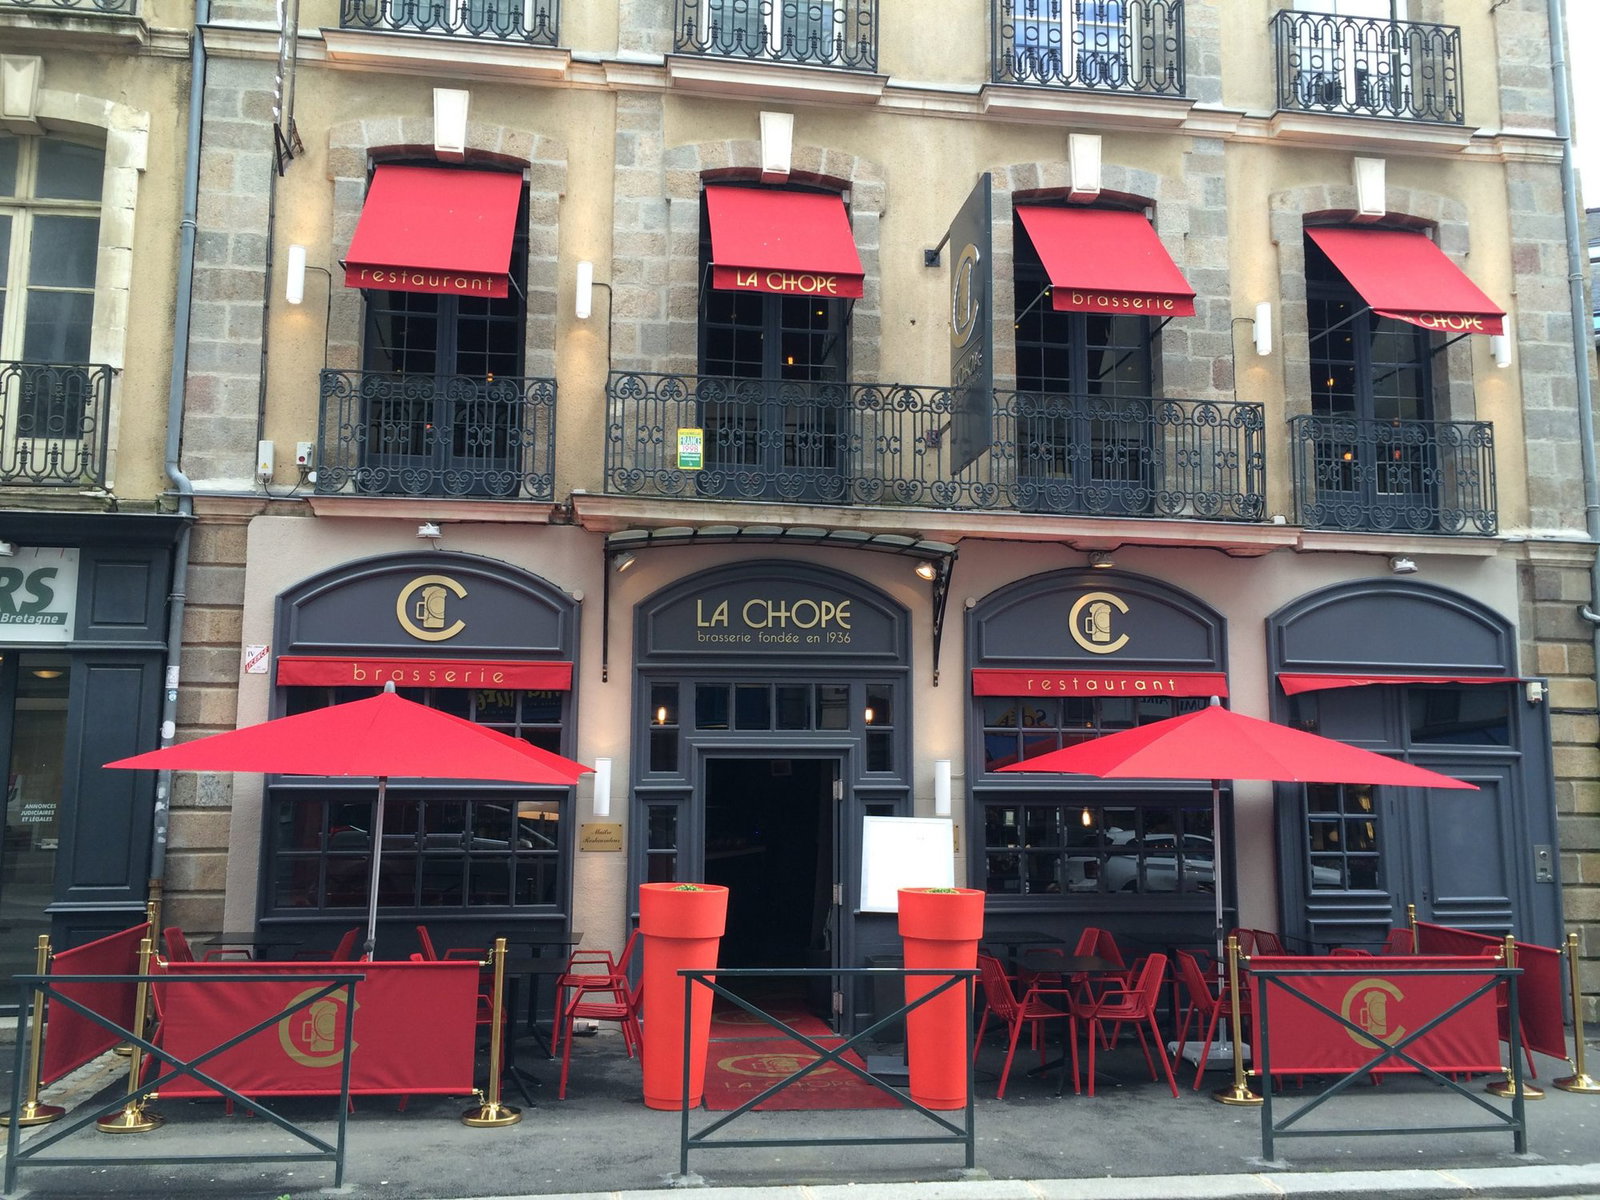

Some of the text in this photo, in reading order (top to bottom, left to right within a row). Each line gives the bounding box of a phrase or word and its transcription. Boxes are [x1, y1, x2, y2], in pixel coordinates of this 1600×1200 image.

[360, 268, 493, 291] restaurant
[736, 270, 837, 294] LA CHOPE
[1072, 290, 1174, 310] brasserie
[1420, 313, 1484, 330] CHOPE
[680, 436, 702, 446] FRANCE
[1, 612, 59, 625] Bretagne
[697, 598, 851, 629] LA CHOPE
[697, 631, 851, 644] brasserie fondée en 1936
[353, 663, 504, 684] brasserie
[1027, 677, 1176, 692] restaurant
